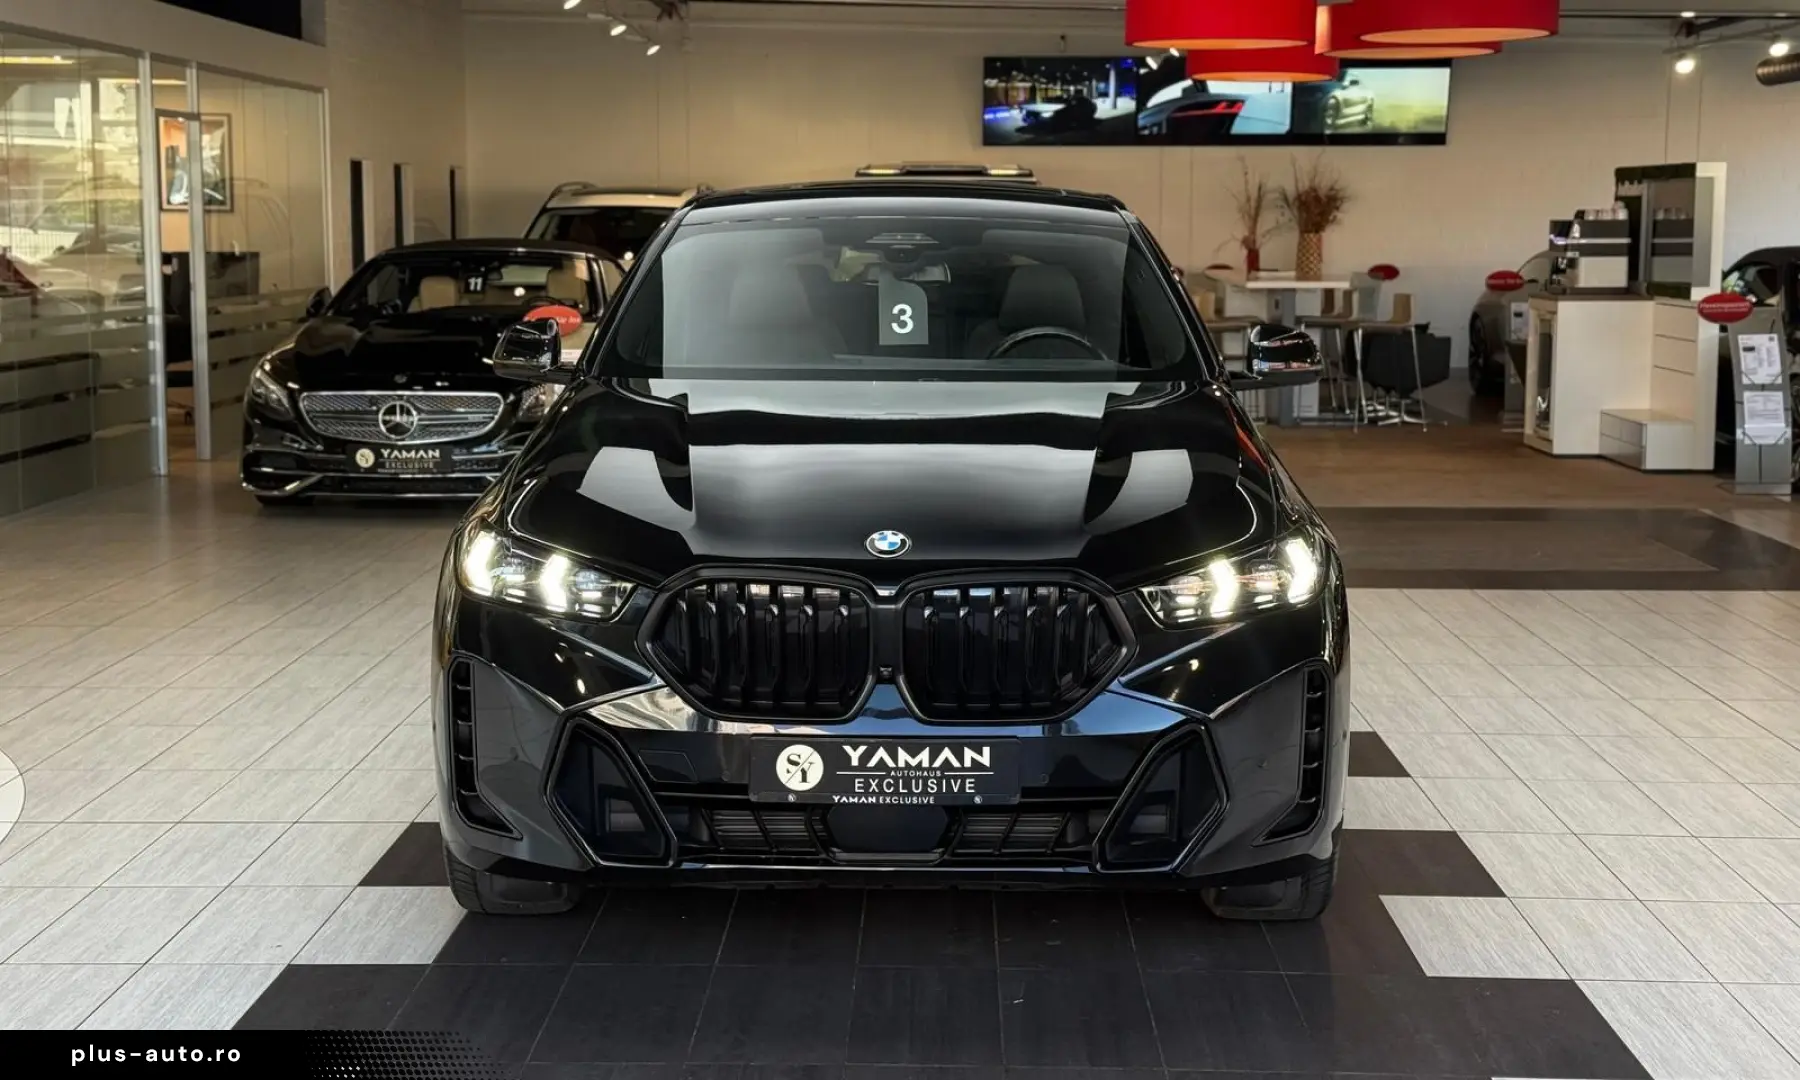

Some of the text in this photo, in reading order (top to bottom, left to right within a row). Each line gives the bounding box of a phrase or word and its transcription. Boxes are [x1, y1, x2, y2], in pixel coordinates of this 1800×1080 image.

[467, 277, 483, 292] 11
[891, 303, 914, 334] 3
[380, 448, 440, 459] YAMAN
[385, 461, 434, 469] EXCLUSIVE
[842, 745, 991, 768] YAMAN
[855, 778, 976, 793] EXCLUSIVE
[832, 795, 935, 804] YAMAN EXCLUSIVE
